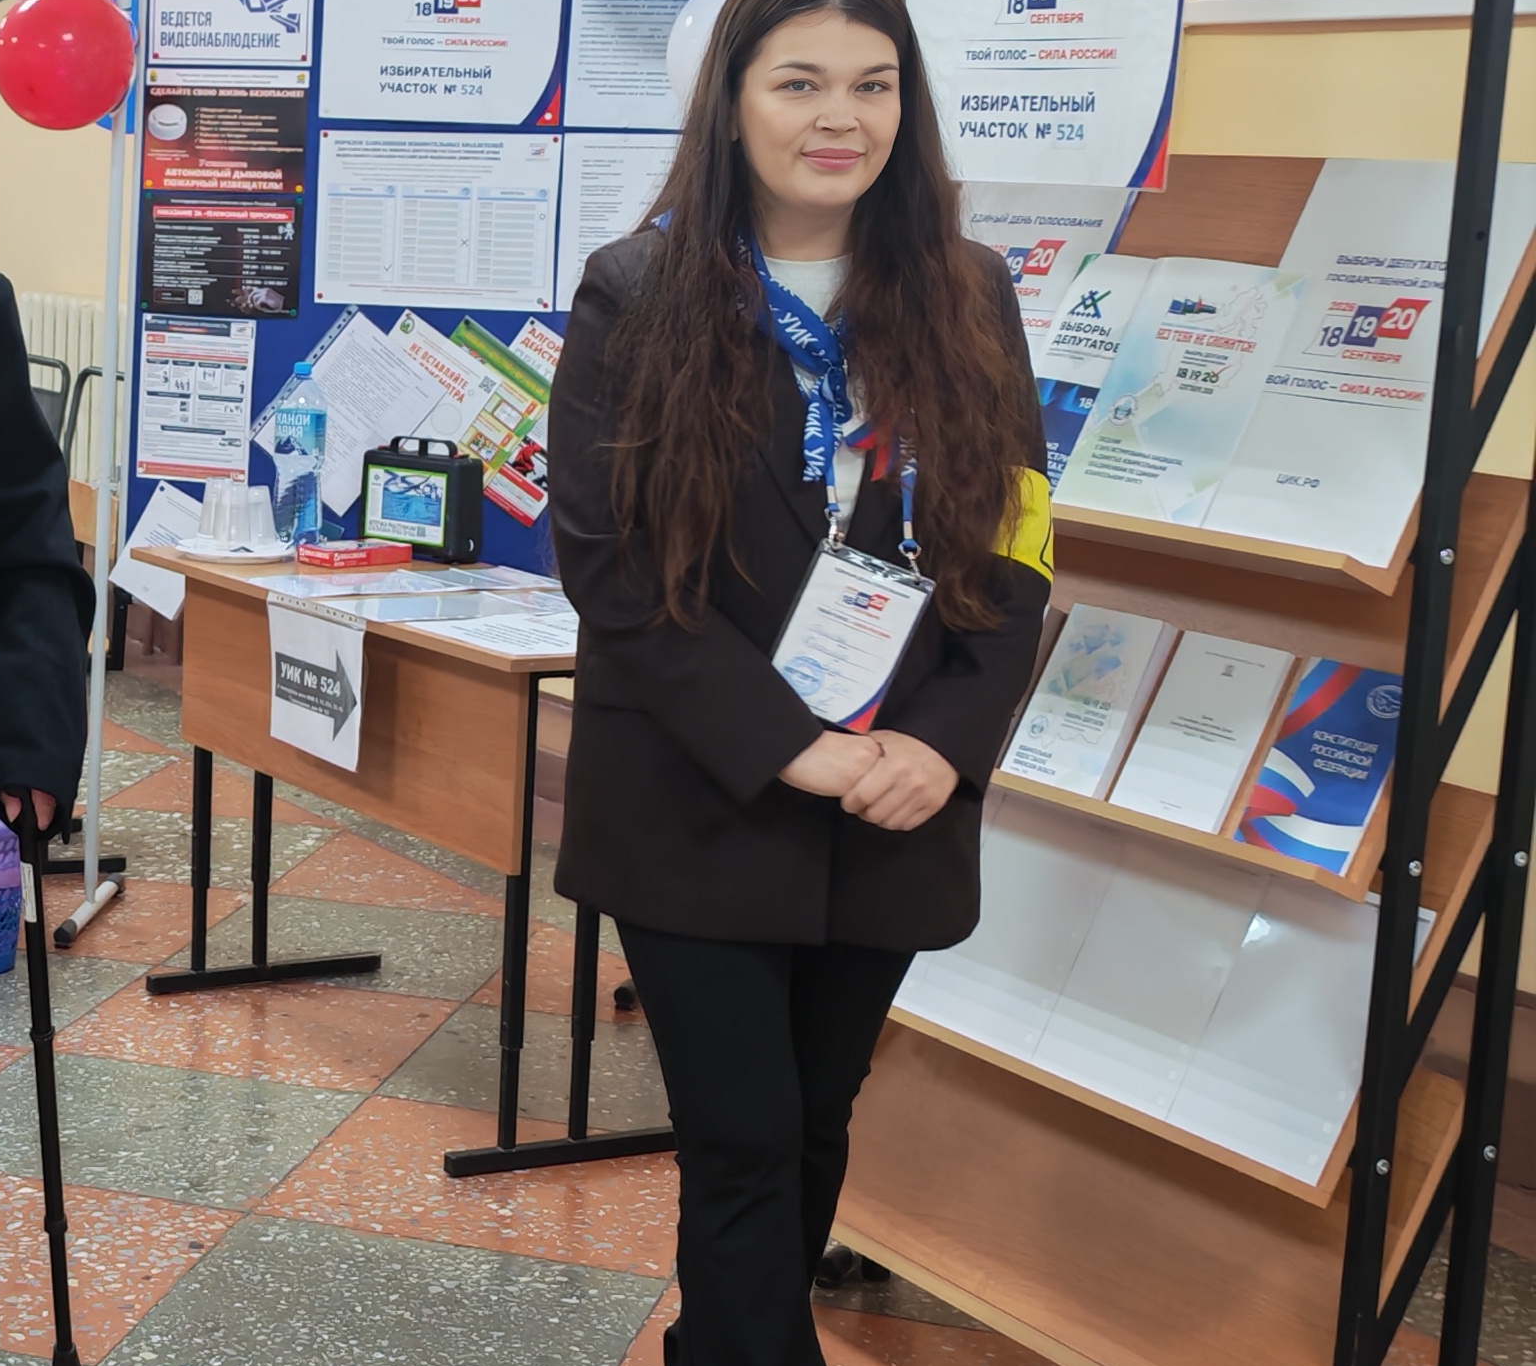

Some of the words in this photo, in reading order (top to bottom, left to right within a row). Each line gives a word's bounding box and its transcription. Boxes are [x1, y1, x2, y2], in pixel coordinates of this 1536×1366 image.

[415, 2, 432, 16] 18
[160, 11, 212, 27] ВЕДЕТСЯ
[1030, 12, 1084, 25] СЕНТЯБРЯ
[160, 31, 282, 49] ВИДЕОНАБЛЮДЕНИЕ
[382, 36, 404, 45] ТВОЙ
[406, 37, 435, 46] ГОЛОС
[965, 48, 992, 61] ТВОЙ
[993, 49, 1027, 61] ГОЛОС
[1038, 48, 1068, 61] СИЛА
[1070, 48, 1118, 61] РОССИИ!
[380, 65, 493, 79] ИЗБИРАТЕЛЬНЫЙ
[379, 82, 438, 95] УЧАСТОК
[443, 84, 457, 95] №
[460, 84, 483, 96] 524
[960, 91, 1096, 113] ИЗБИРАТЕЛЬНЫЙ
[959, 121, 1028, 139] УЧАСТОК
[1035, 122, 1052, 139] №
[1055, 123, 1085, 141] 524
[971, 212, 1009, 223] ЕДИНЫЙ
[1008, 216, 1033, 225] ДЕНЬ
[1033, 216, 1104, 228] ГОЛОСОВАНИЯ
[1026, 248, 1056, 269] 20
[778, 311, 820, 349] УИК
[1059, 321, 1112, 336] ВЫБОРЫ
[1319, 325, 1344, 347] 18
[1350, 316, 1378, 338] 19
[1382, 307, 1418, 331] 20
[1341, 349, 1403, 364] СЕНТЯБРЯ
[409, 342, 421, 356] НЕ
[420, 350, 470, 390] ОСТАВЛЯЙТЕ
[1291, 376, 1329, 390] ГОЛОС
[280, 661, 302, 685] УИК
[304, 669, 318, 689] №
[319, 676, 341, 698] 524
